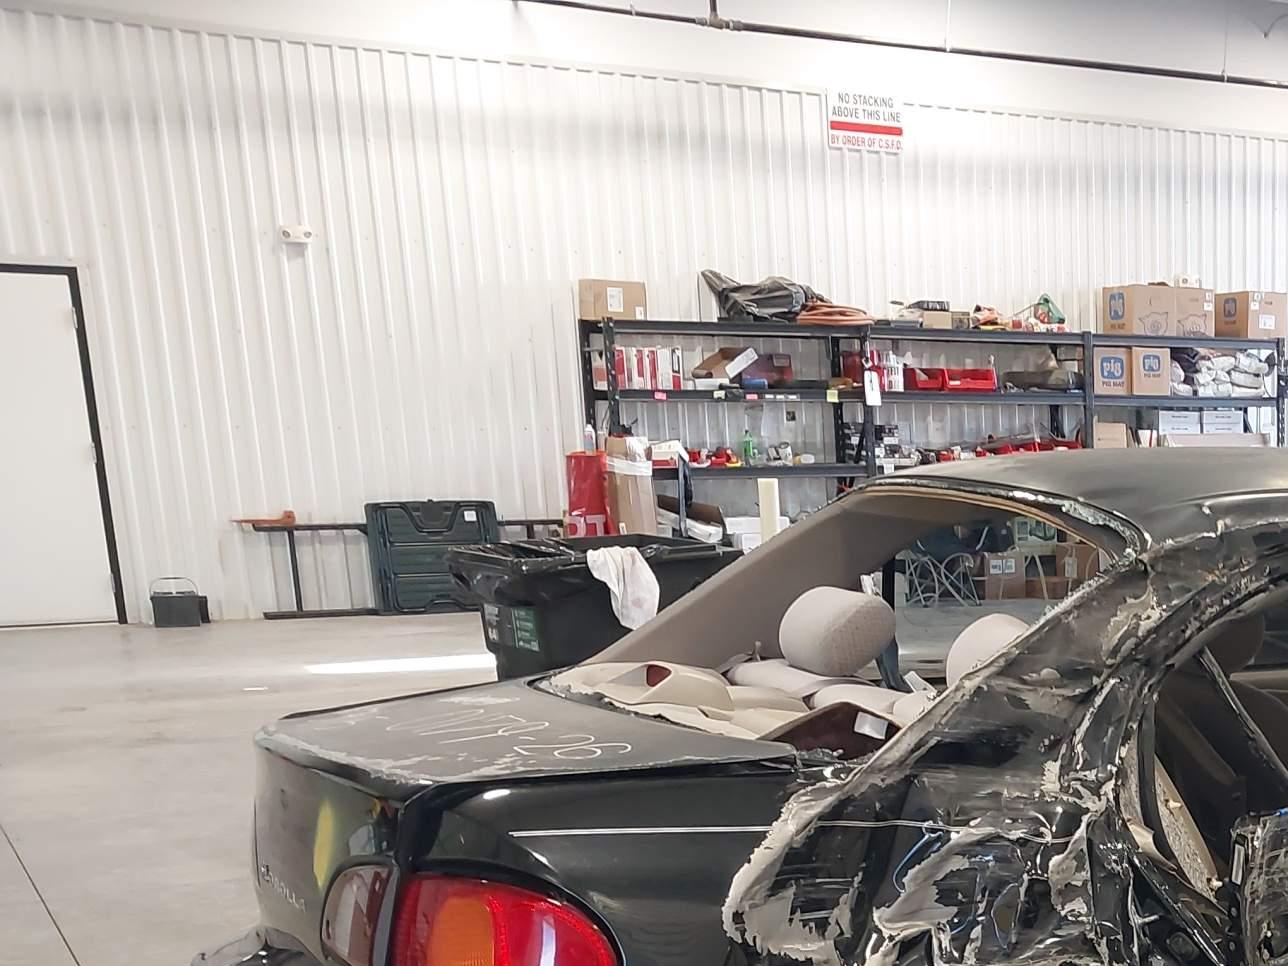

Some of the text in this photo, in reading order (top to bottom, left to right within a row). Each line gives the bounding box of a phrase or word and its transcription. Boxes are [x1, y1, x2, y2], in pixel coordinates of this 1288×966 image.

[838, 92, 894, 109] NO STACKING
[832, 105, 902, 123] ABOVE THIS LINE
[831, 133, 840, 145] BY
[842, 135, 866, 147] ORDER
[867, 137, 877, 148] OF
[1103, 359, 1122, 377] pig
